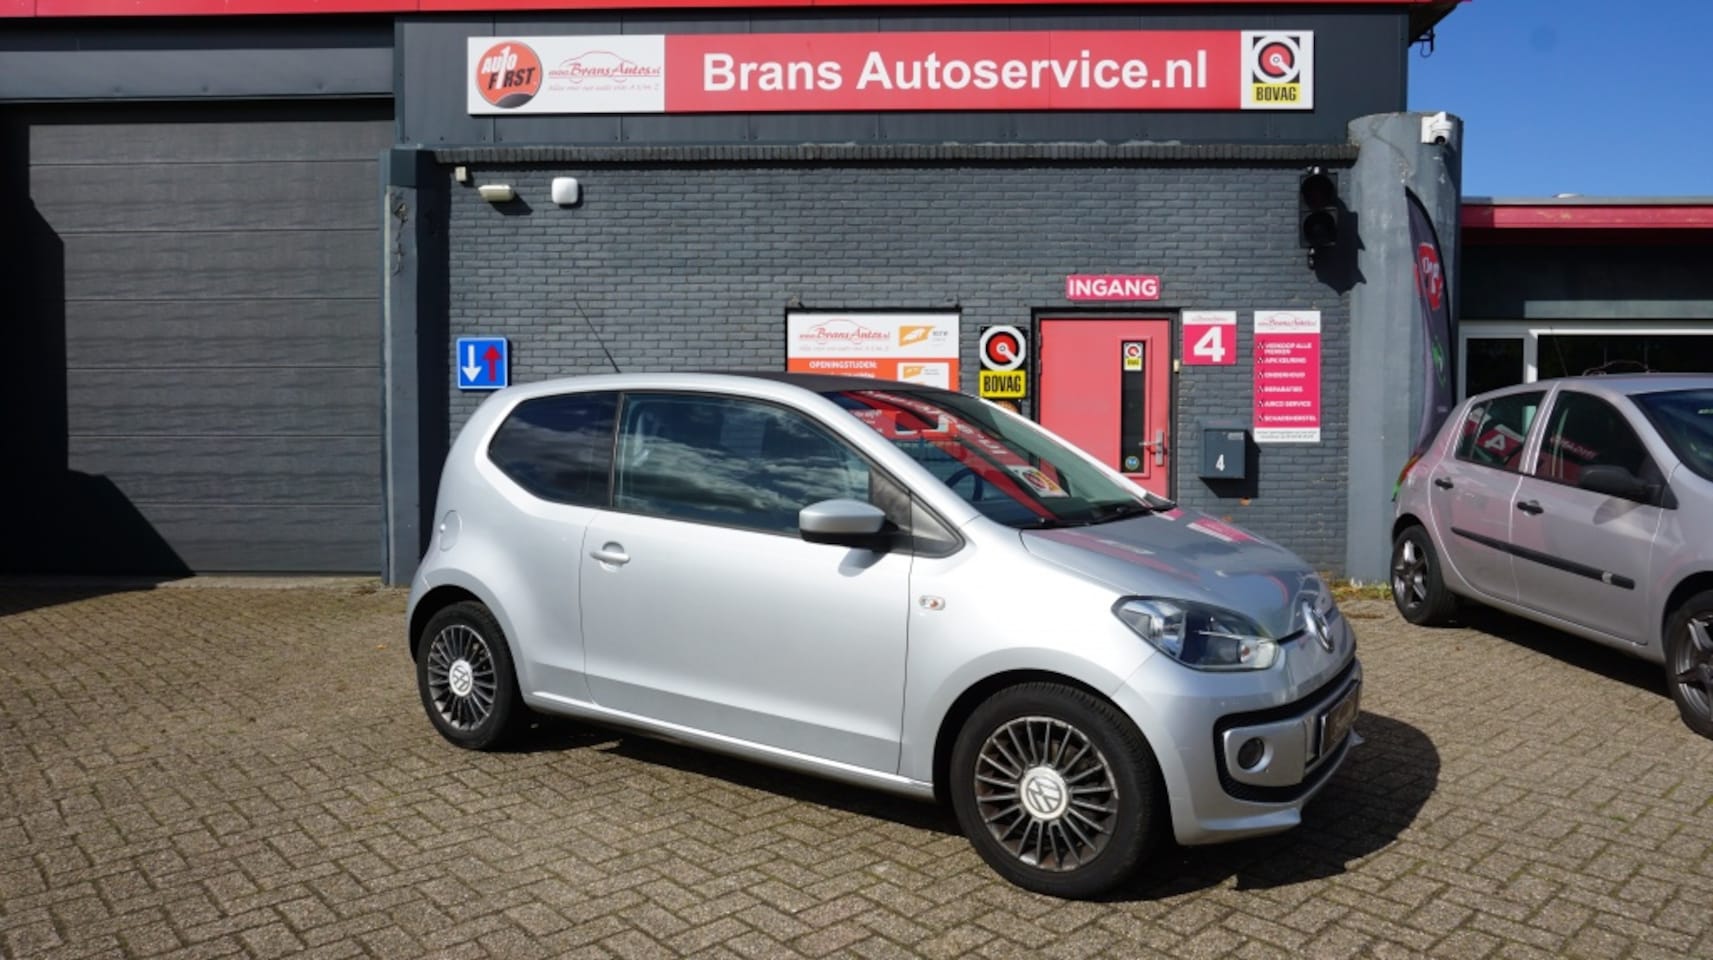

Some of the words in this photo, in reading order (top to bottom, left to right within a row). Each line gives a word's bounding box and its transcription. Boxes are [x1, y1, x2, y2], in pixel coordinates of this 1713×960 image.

[703, 52, 843, 91] Brans
[855, 50, 1207, 90] Autoservice.nl
[1255, 86, 1297, 102] BOVAG
[1068, 279, 1158, 297] INGANG
[1193, 326, 1226, 362] 4
[983, 376, 1022, 392] BOVAG
[1215, 453, 1226, 472] 4
